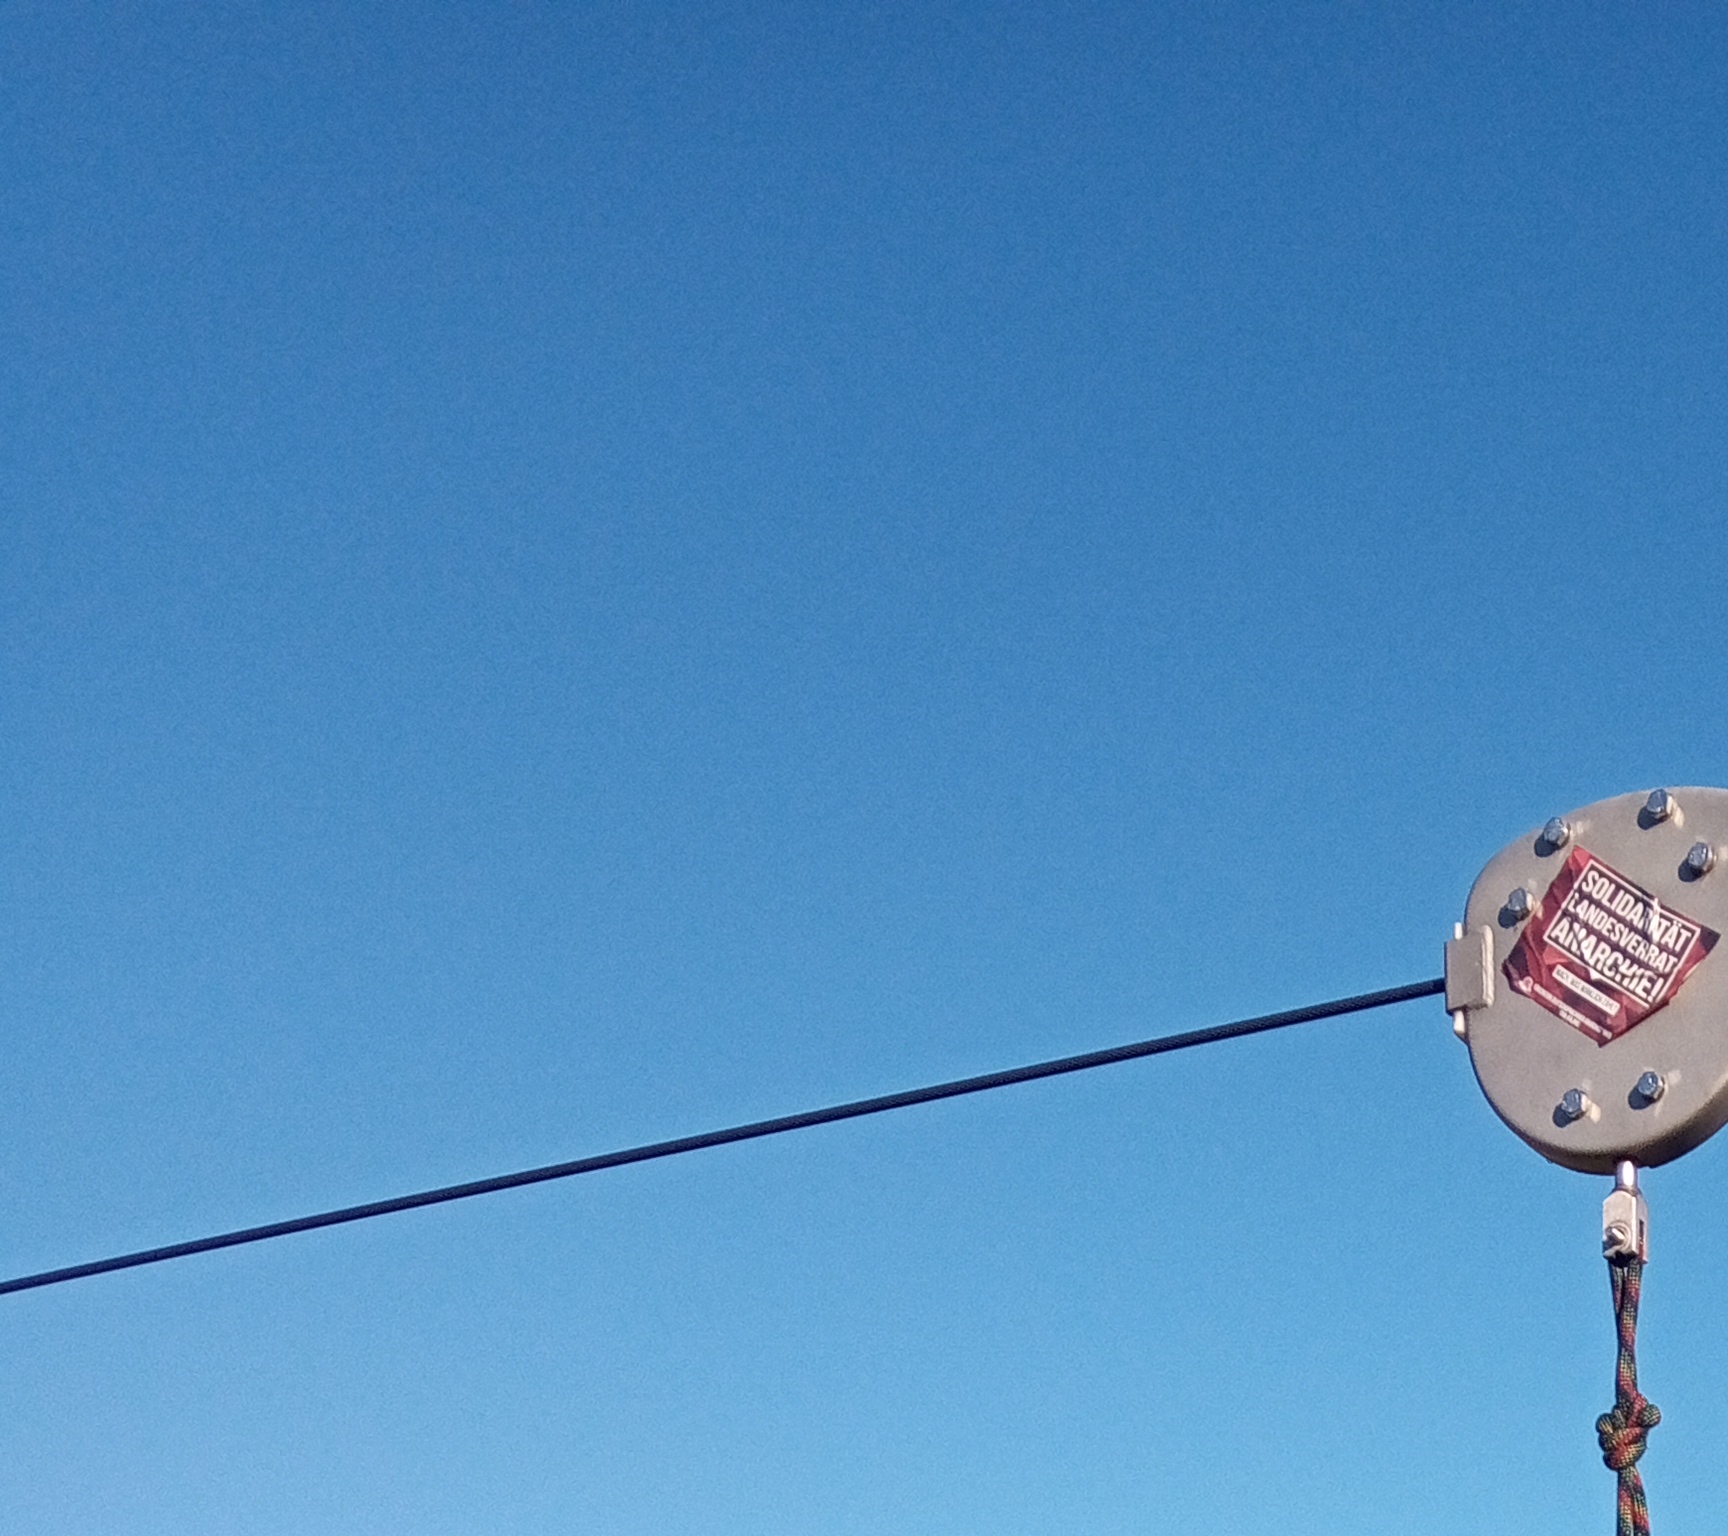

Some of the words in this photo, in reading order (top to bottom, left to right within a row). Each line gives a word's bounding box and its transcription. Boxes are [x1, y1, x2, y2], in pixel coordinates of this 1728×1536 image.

[1568, 893, 1678, 974] LANDESVERRAT
[1581, 870, 1692, 953] SOLIDARITÄT
[1550, 917, 1664, 1002] ANARCHIE!
